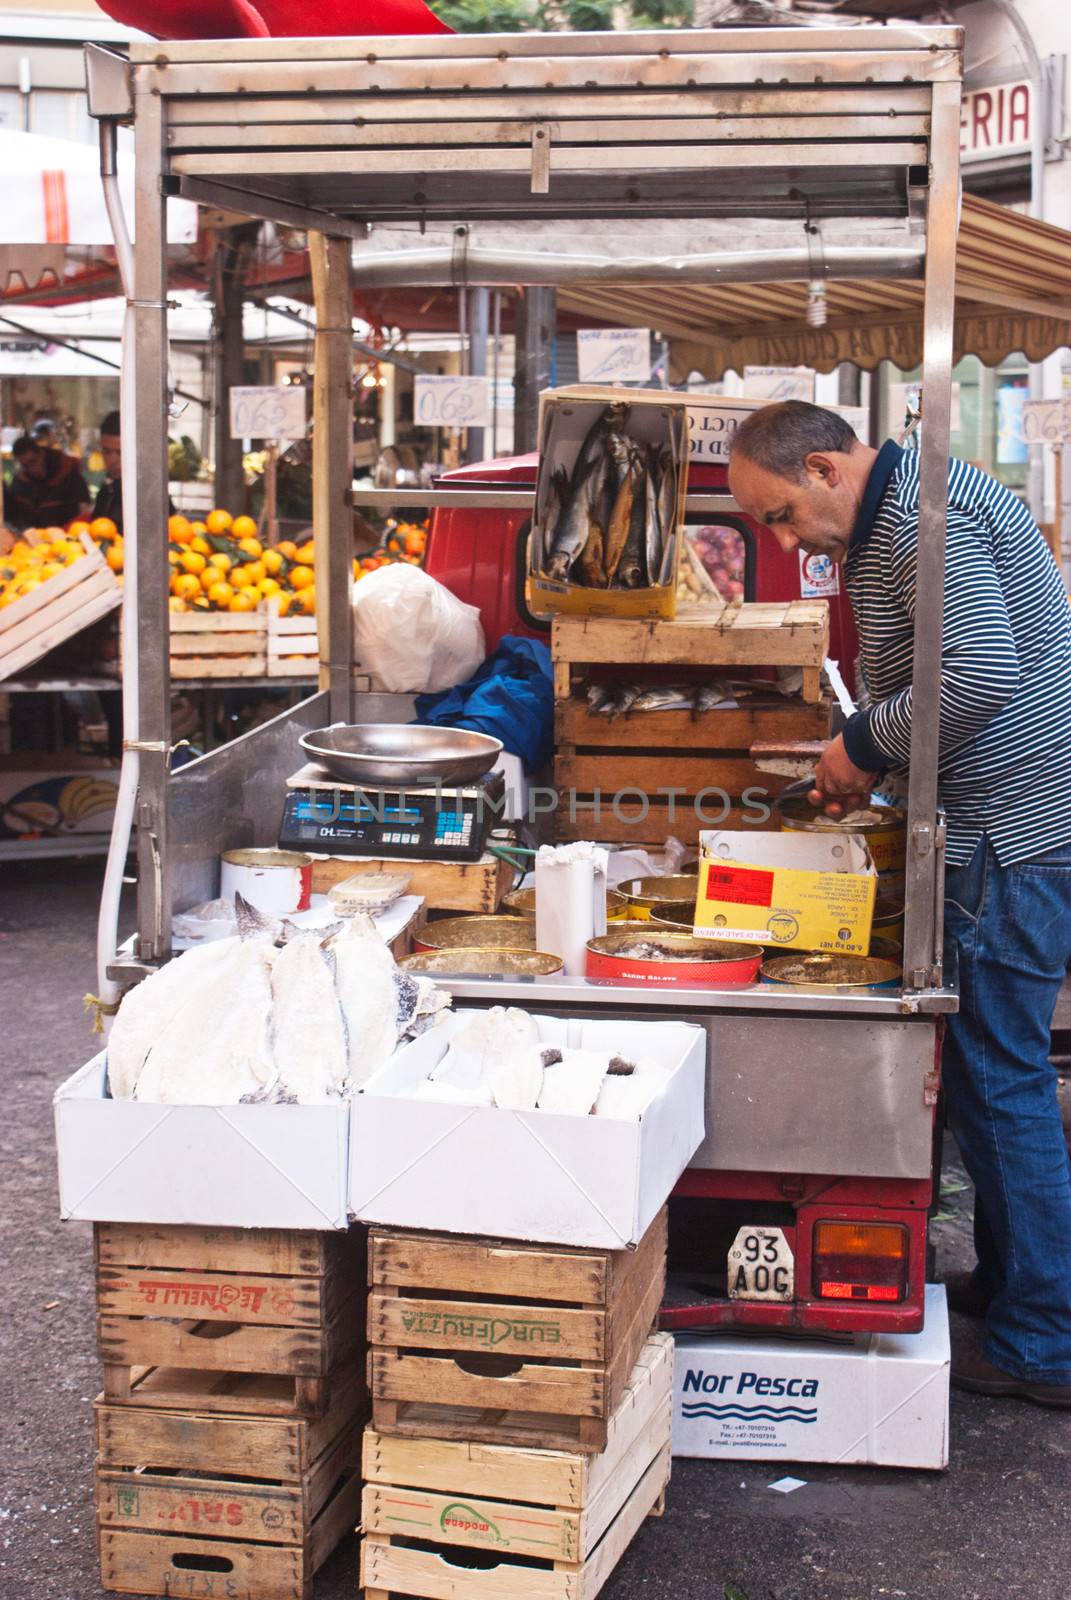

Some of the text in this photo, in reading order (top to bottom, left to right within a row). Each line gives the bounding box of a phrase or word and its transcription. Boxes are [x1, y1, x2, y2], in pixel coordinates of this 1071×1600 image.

[744, 1235, 779, 1263] 93
[682, 1369, 820, 1398] Nor Pesca
